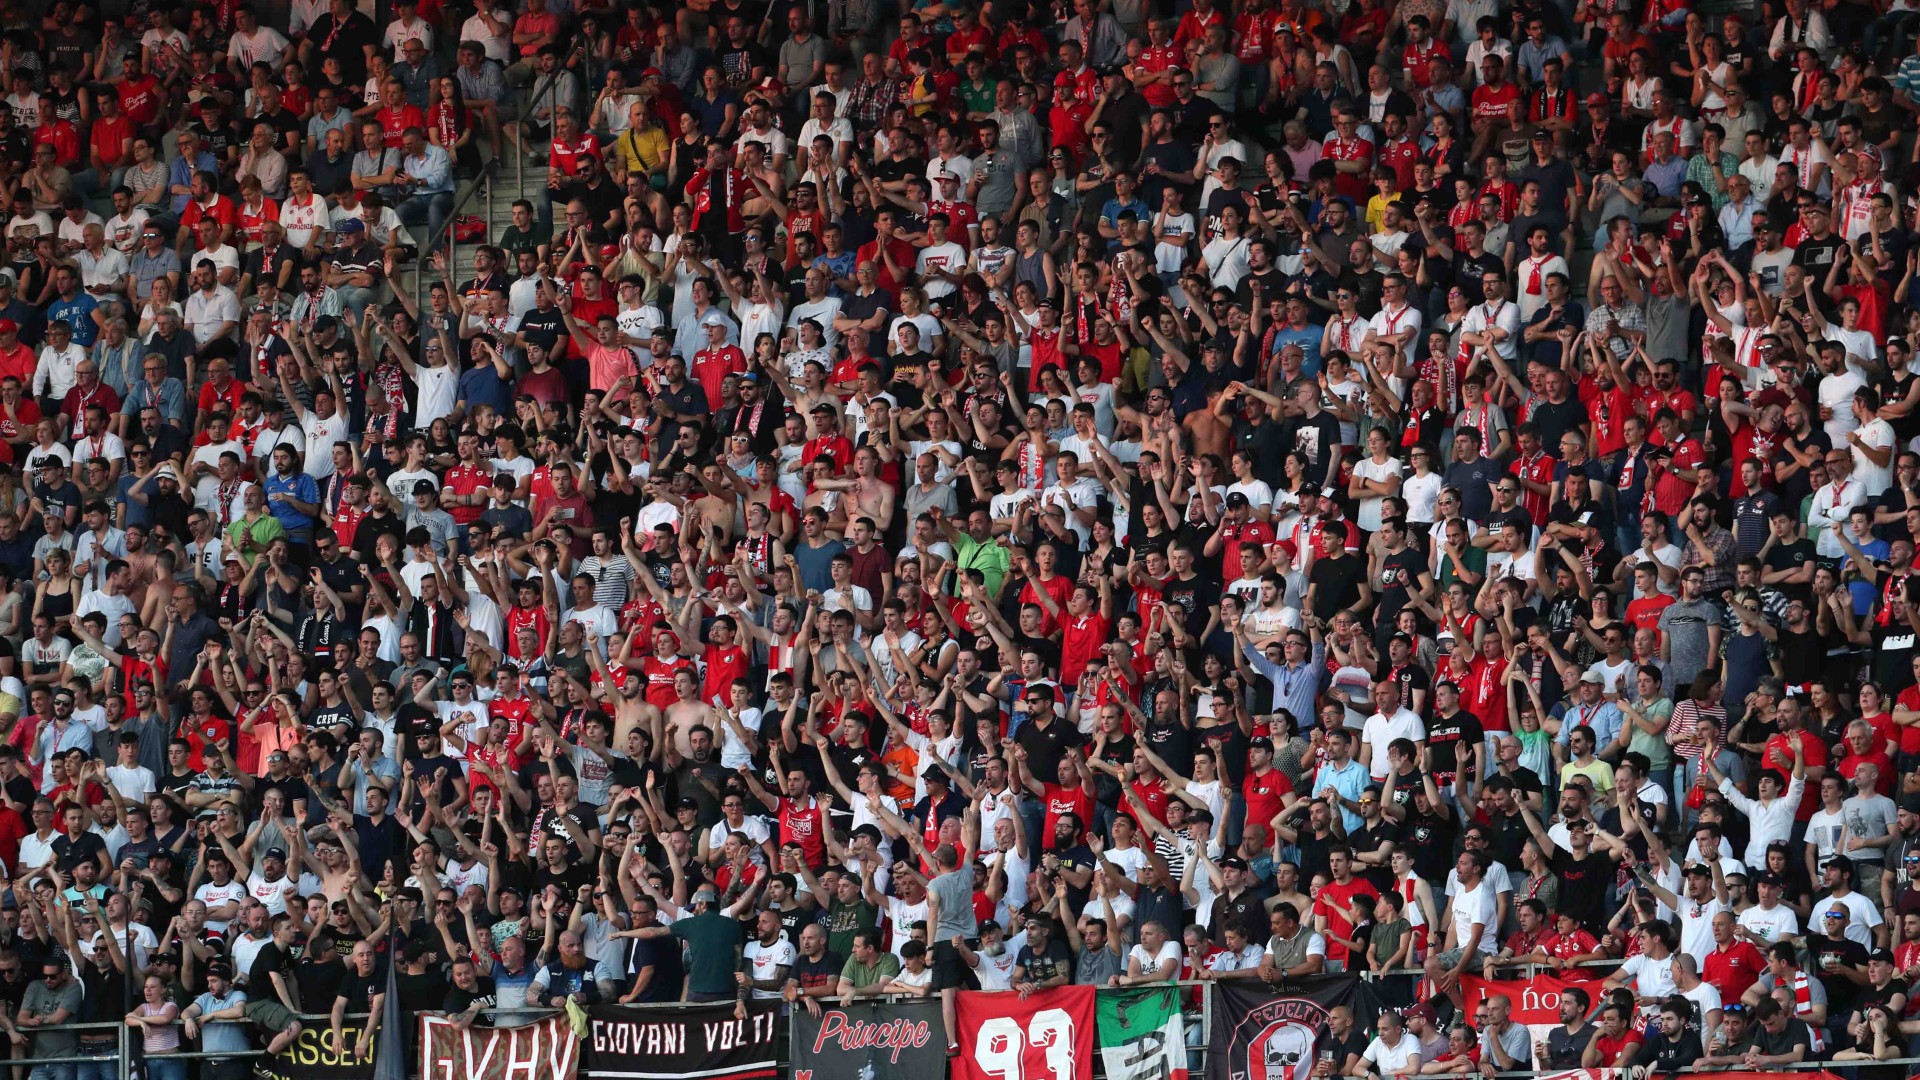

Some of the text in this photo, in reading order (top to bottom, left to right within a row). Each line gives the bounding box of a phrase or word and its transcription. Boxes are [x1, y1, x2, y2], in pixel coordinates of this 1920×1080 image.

[316, 713, 339, 725] CREW
[592, 1011, 775, 1054] GIOVANI VOLTI
[812, 1010, 932, 1063] Principe
[974, 1008, 1077, 1080] 93
